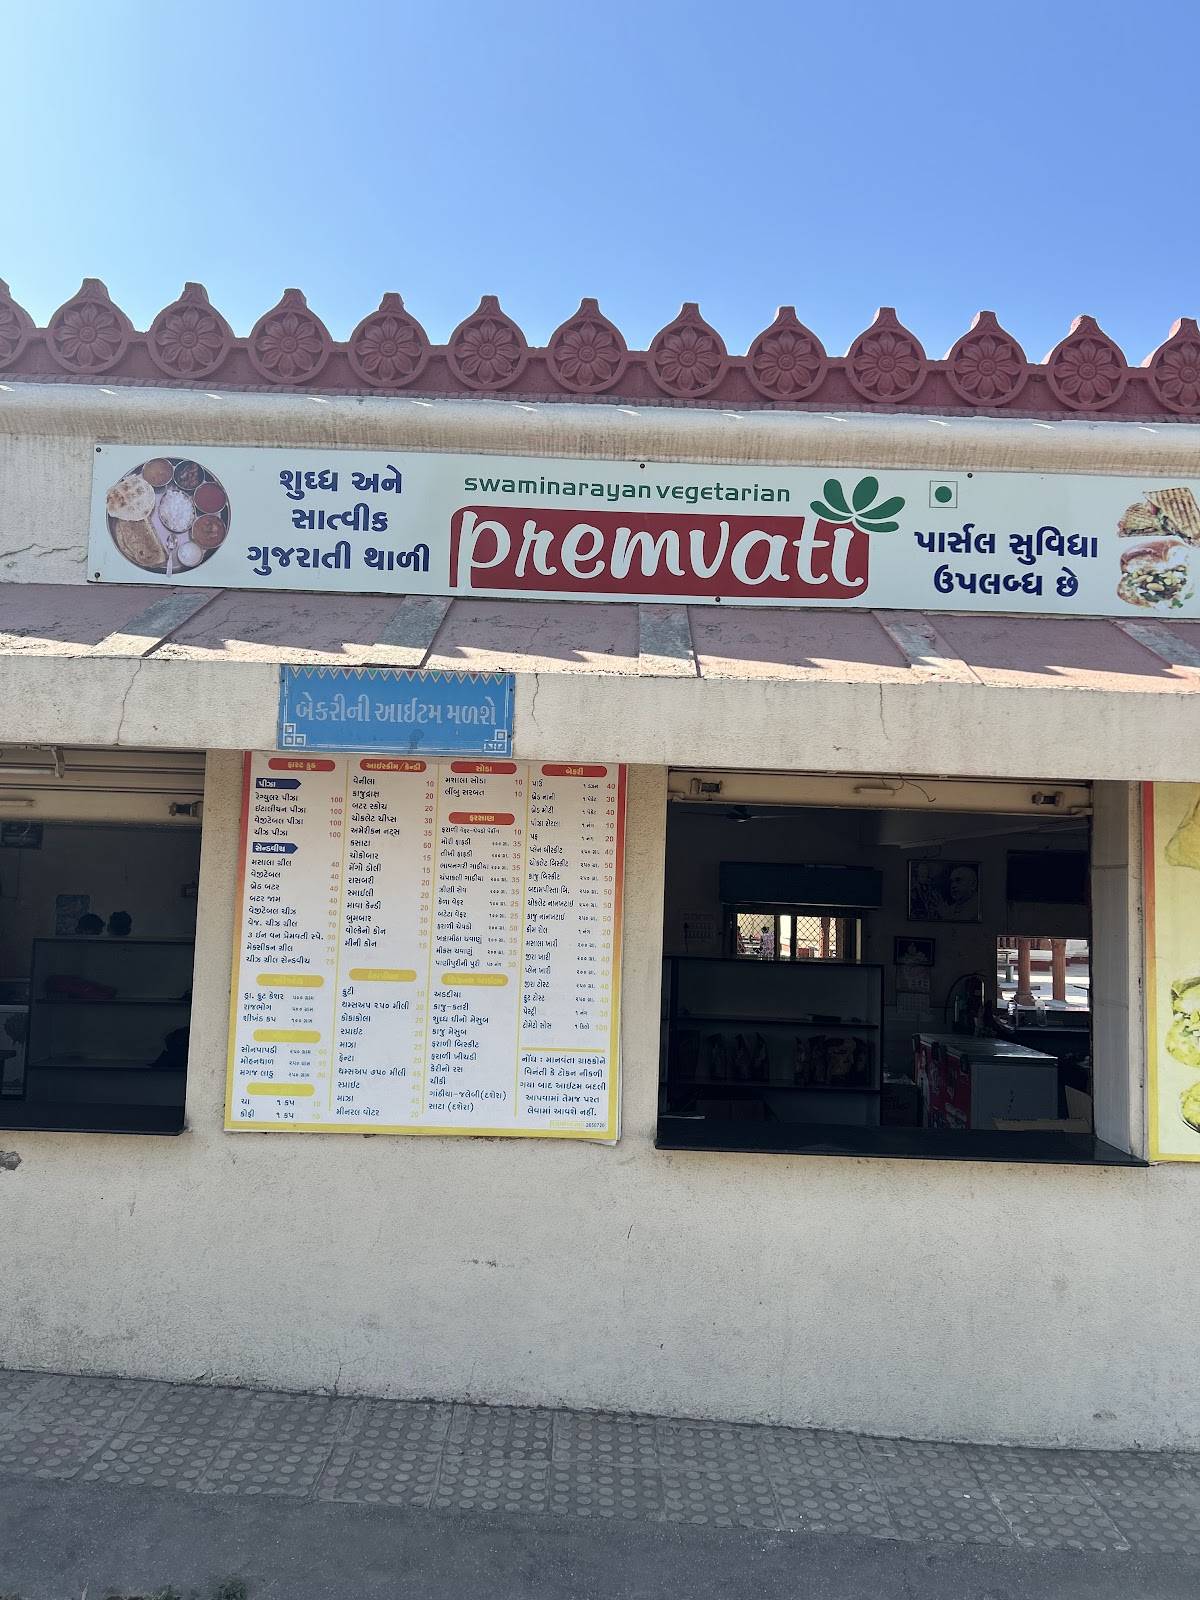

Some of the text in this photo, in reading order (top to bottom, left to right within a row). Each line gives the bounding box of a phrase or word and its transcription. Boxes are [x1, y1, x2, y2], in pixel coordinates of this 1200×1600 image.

[352, 464, 402, 494] અને
[464, 476, 790, 504] swaminarayan vegetarian
[292, 503, 388, 532] સાત્વીક
[246, 541, 430, 576] ગુજરાતી થાળી
[457, 510, 864, 589] premvati
[914, 523, 1097, 565] પાર્સલ સુવિધા
[934, 564, 1078, 597] ઉપલબ્ધ છે
[296, 692, 497, 726] બેકરીની આઈટમ મળશે
